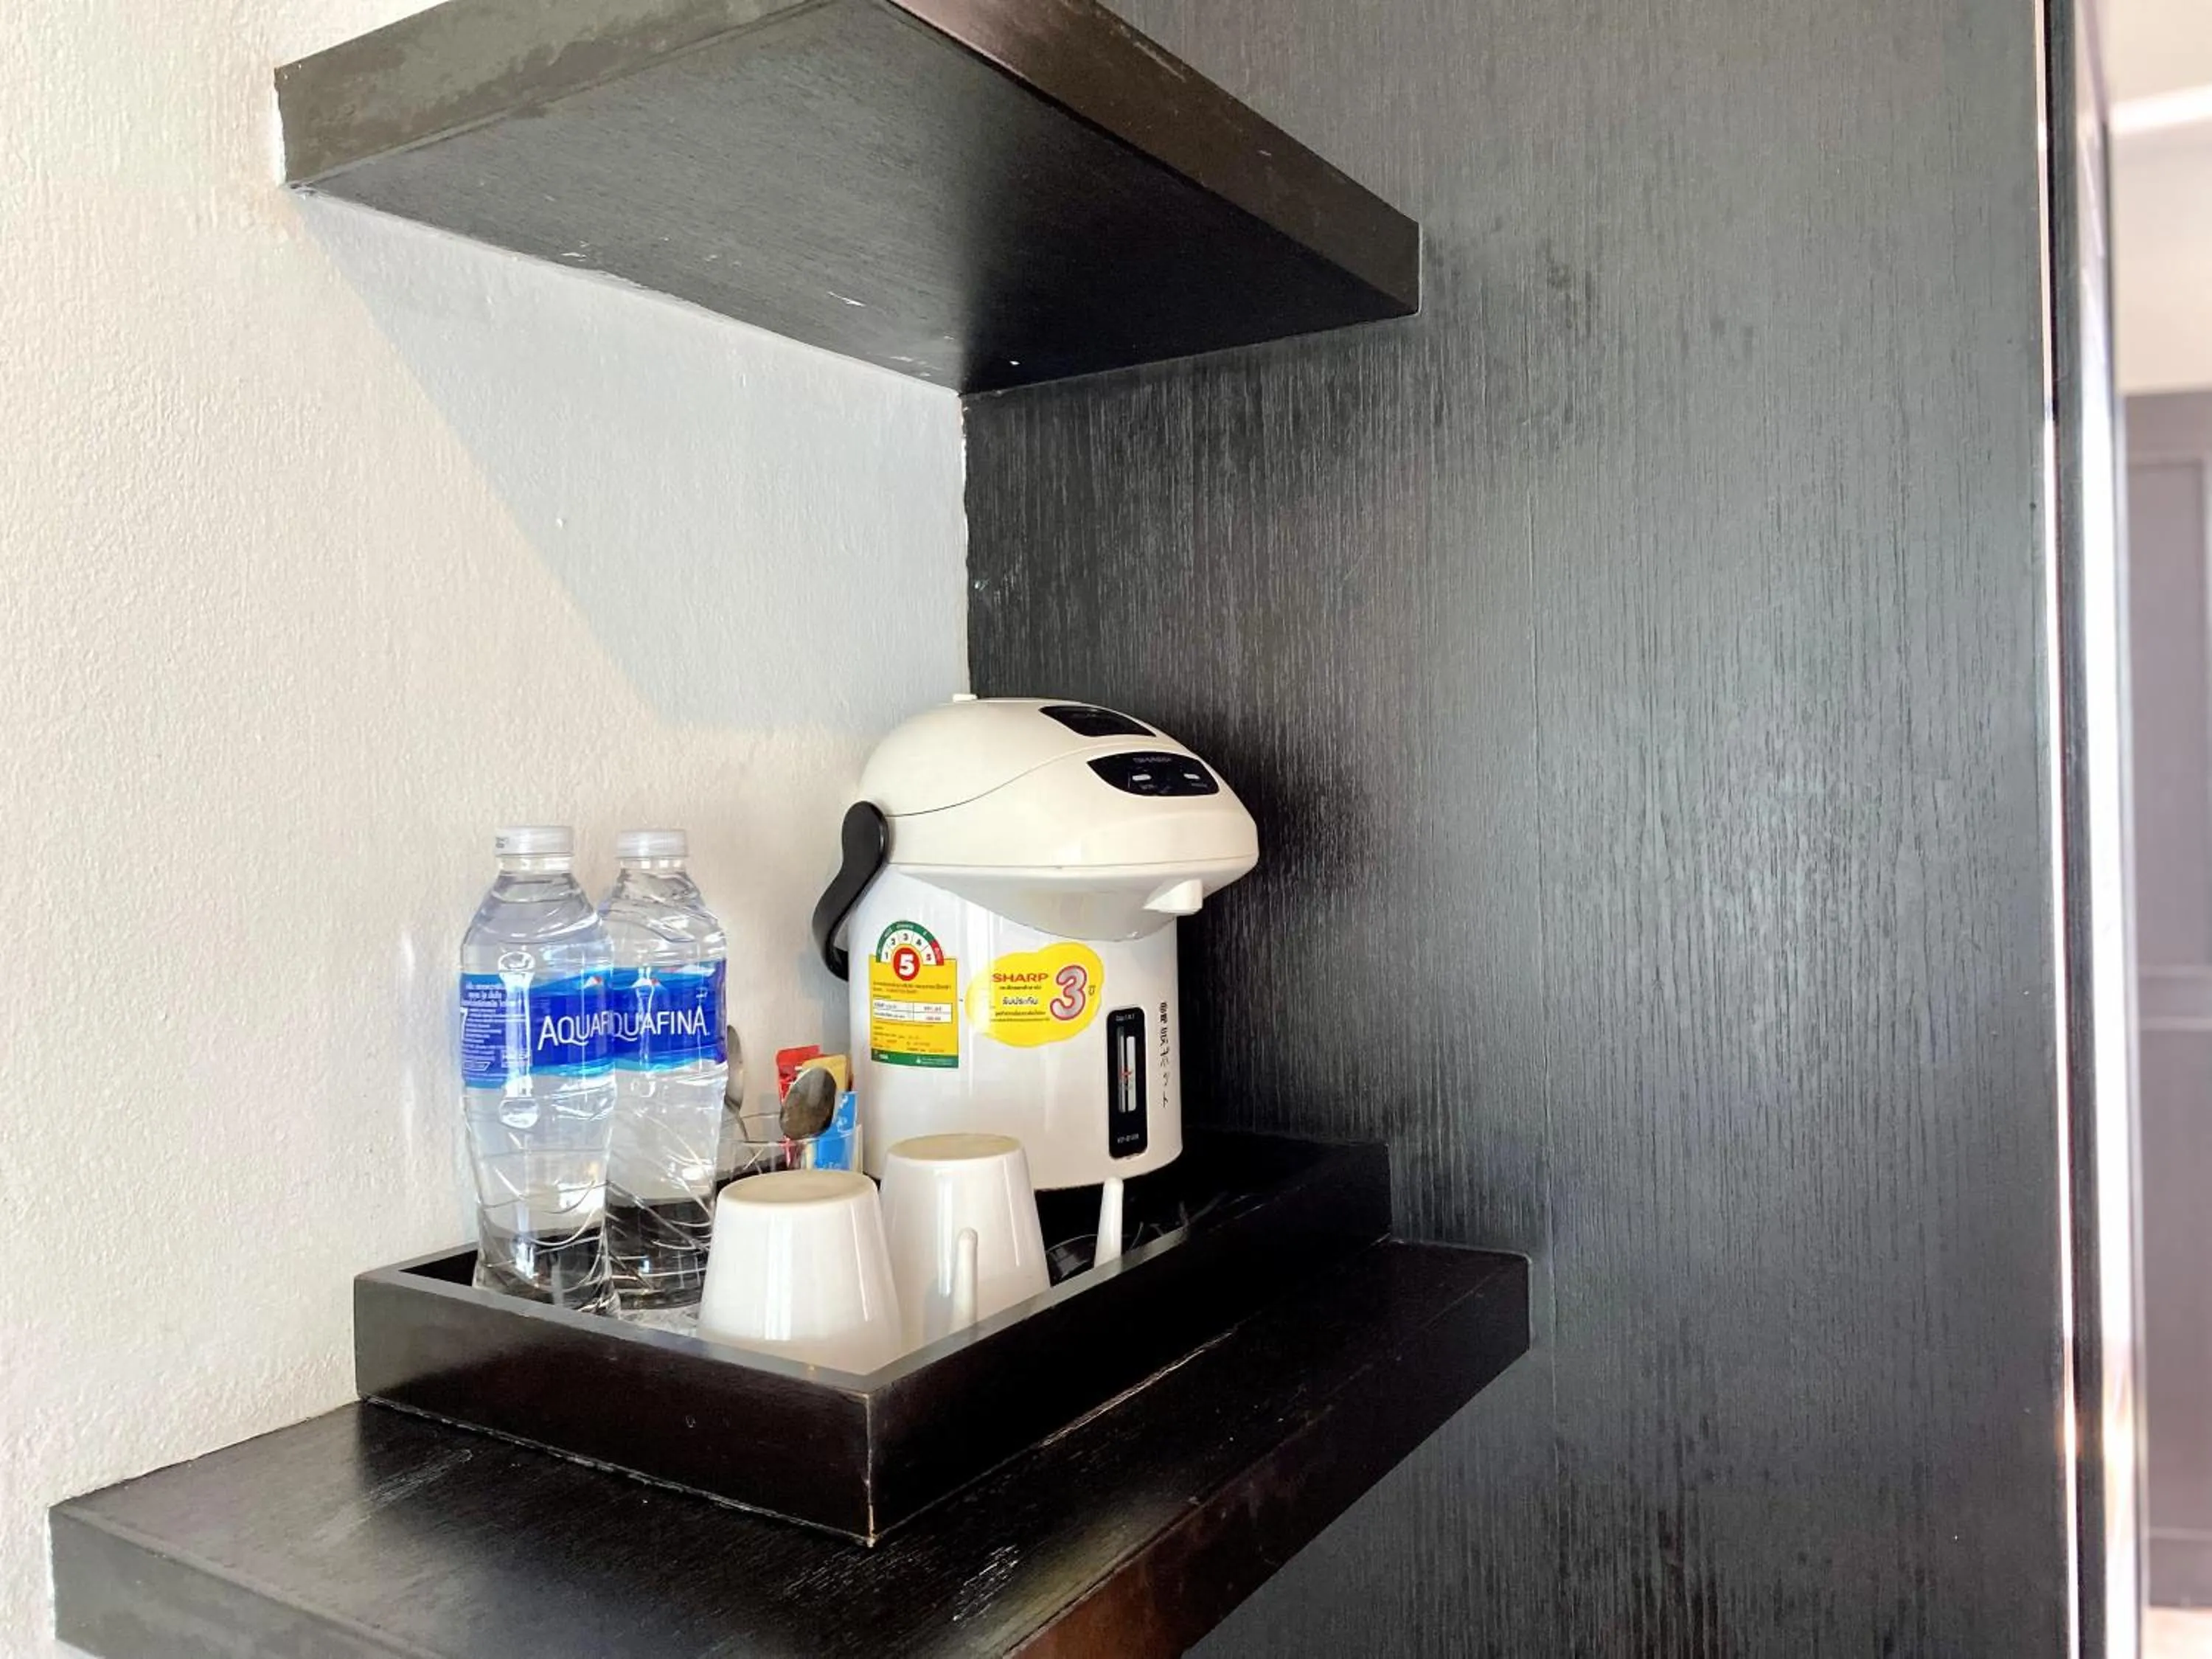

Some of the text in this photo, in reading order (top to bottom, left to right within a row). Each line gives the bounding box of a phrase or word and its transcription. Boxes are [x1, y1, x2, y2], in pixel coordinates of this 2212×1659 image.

[891, 937, 896, 945] 2
[903, 933, 909, 941] 3
[899, 953, 915, 975] 5
[992, 973, 1048, 983] SHARP
[1050, 964, 1088, 1021] 3
[538, 1010, 613, 1051] AQUAF
[613, 1004, 709, 1042] QUAFINA
